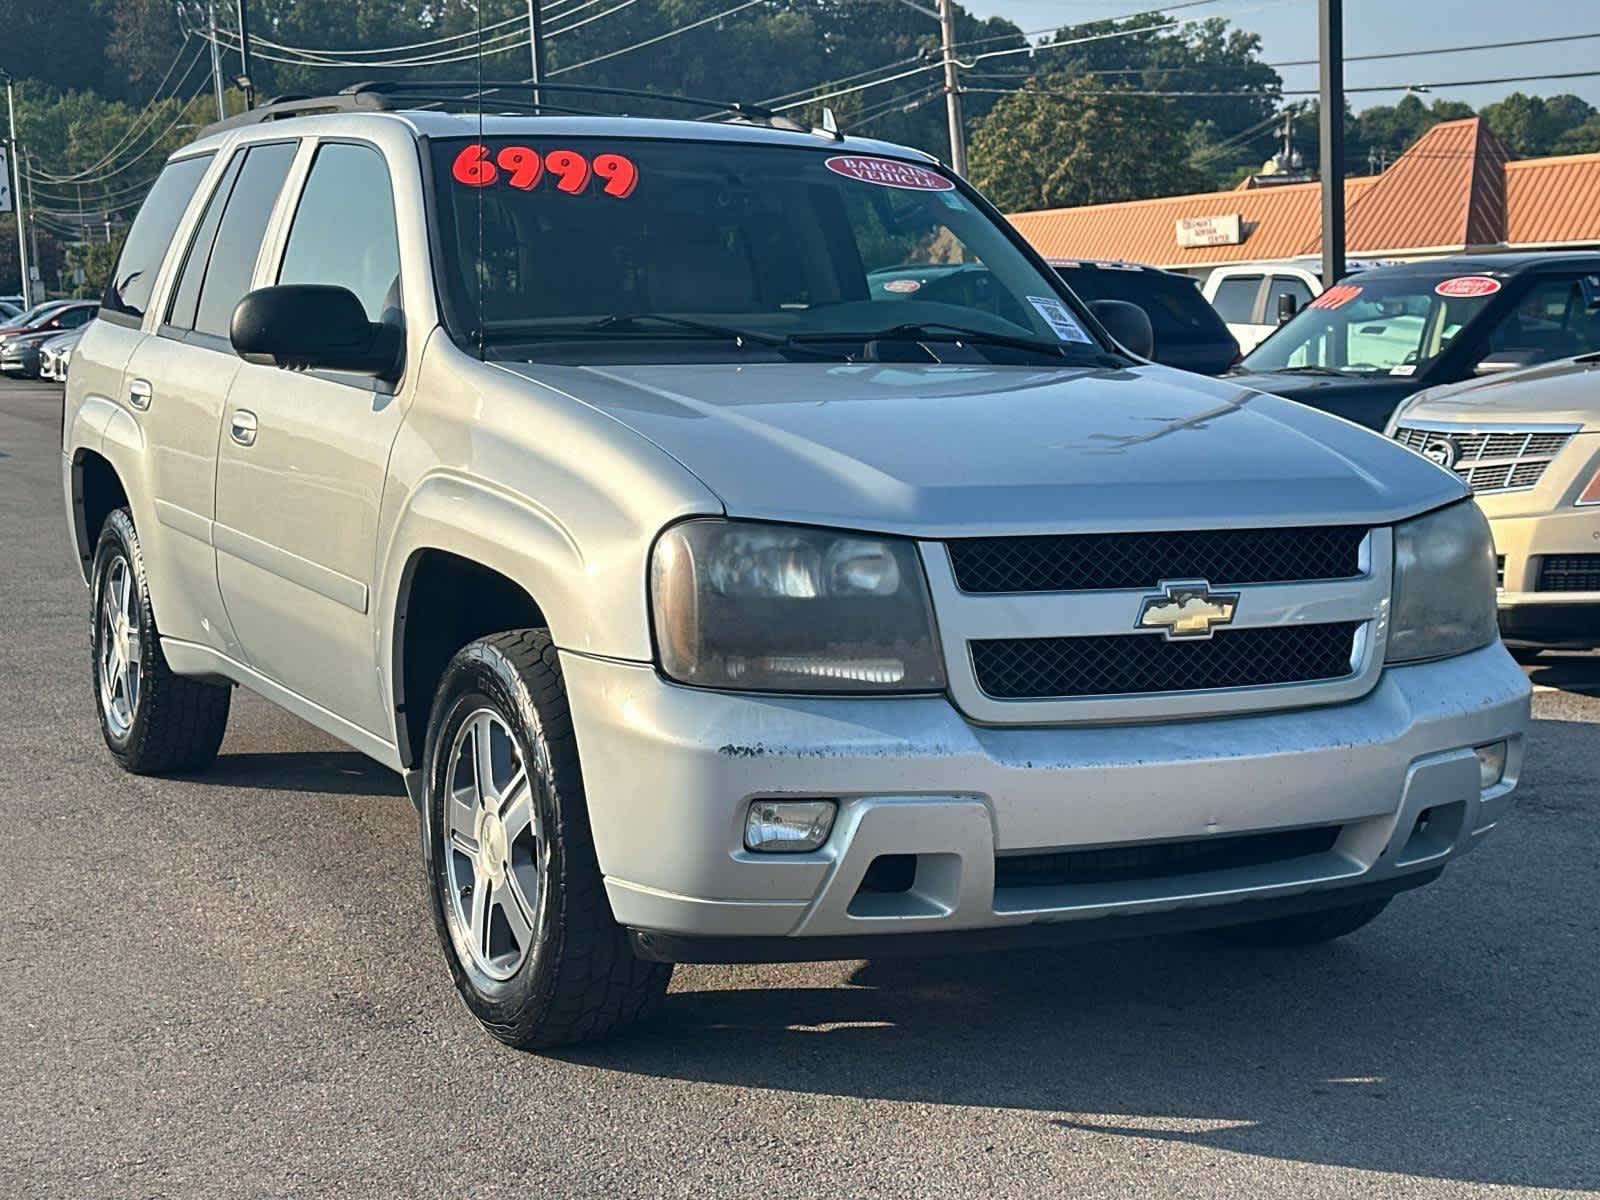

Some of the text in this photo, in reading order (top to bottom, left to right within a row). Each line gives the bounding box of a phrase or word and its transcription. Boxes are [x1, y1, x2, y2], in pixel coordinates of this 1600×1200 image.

[452, 144, 638, 198] 6999
[842, 159, 928, 178] BARGAIN
[851, 168, 939, 188] VEHICLE
